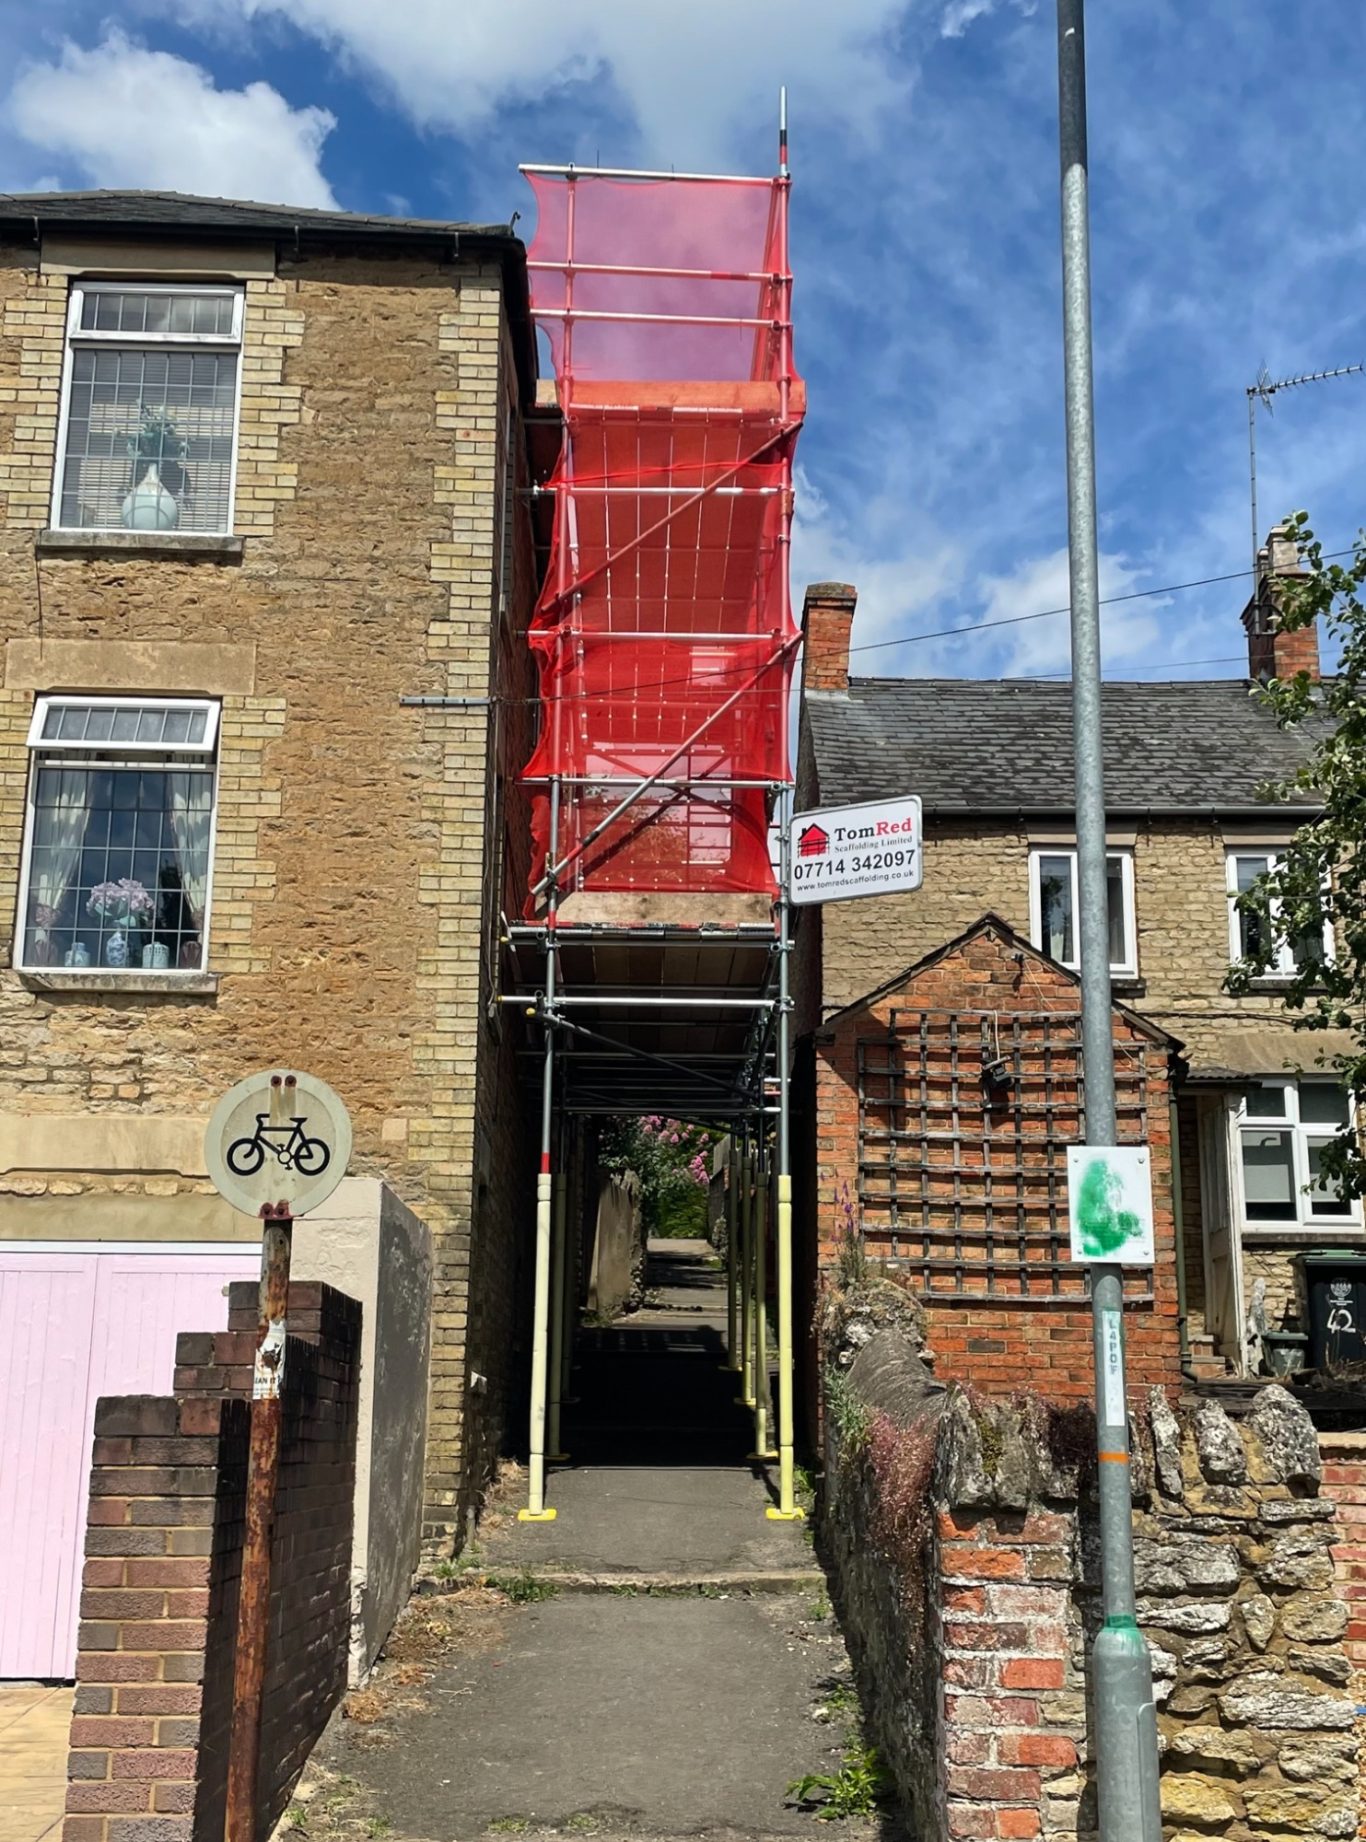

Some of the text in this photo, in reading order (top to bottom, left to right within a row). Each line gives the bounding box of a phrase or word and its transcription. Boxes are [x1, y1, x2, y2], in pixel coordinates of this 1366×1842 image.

[834, 817, 912, 842] TomRed
[834, 835, 913, 853] Scaffolding Limited
[794, 849, 916, 880] 07714 342097
[797, 869, 914, 891] www.tomredscaffolding.co.uk
[1326, 1308, 1357, 1334] 42
